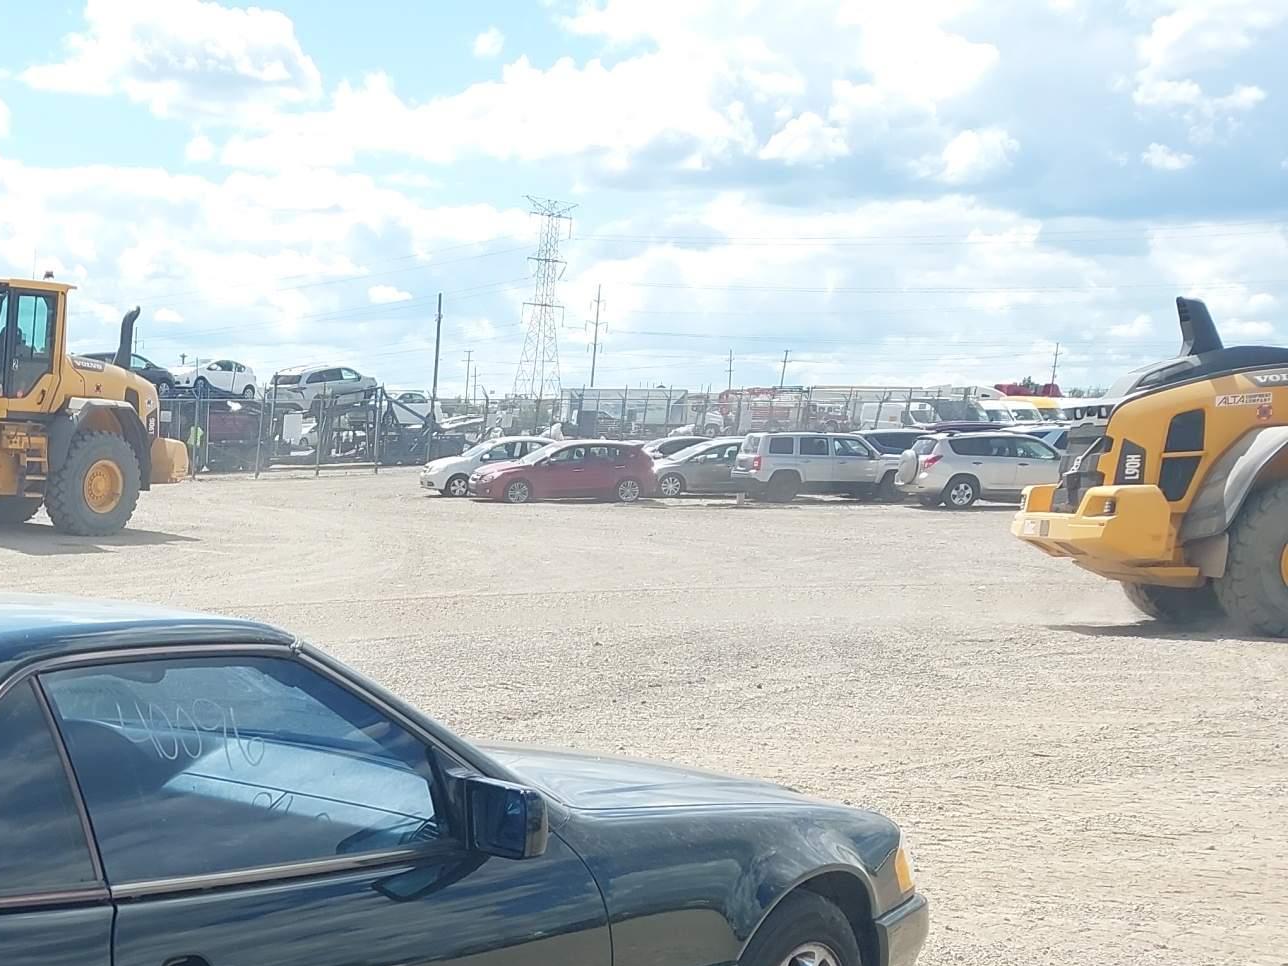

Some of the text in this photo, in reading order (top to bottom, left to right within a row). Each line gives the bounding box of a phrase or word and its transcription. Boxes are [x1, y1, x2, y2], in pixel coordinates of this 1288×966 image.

[1217, 395, 1245, 406] ALTA
[1124, 454, 1142, 480] L90H
[116, 698, 264, 771] 40096
